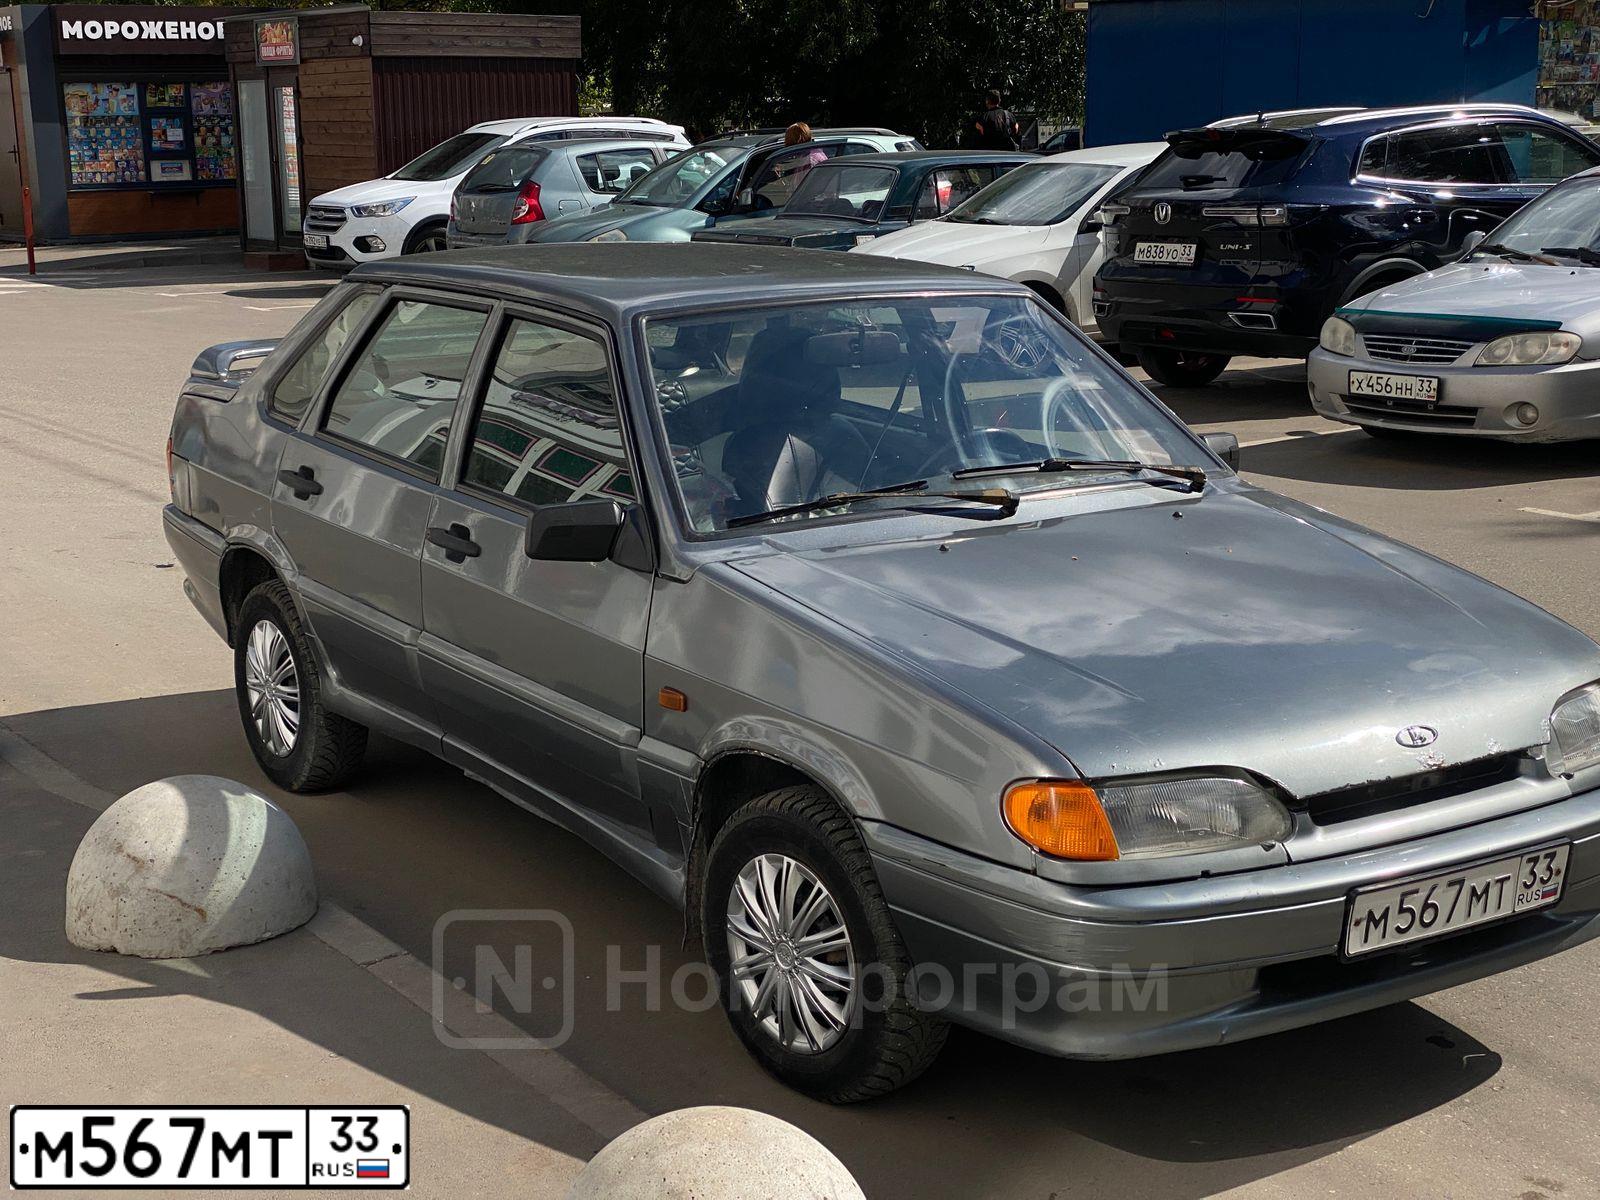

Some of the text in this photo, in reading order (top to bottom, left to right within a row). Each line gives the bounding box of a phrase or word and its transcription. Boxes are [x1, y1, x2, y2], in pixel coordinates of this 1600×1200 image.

[1137, 245, 1193, 260] М838УО 33
[1356, 376, 1433, 396] Х456НН 33
[1362, 850, 1557, 944] М567МТ 33
[1517, 890, 1542, 906] RUS
